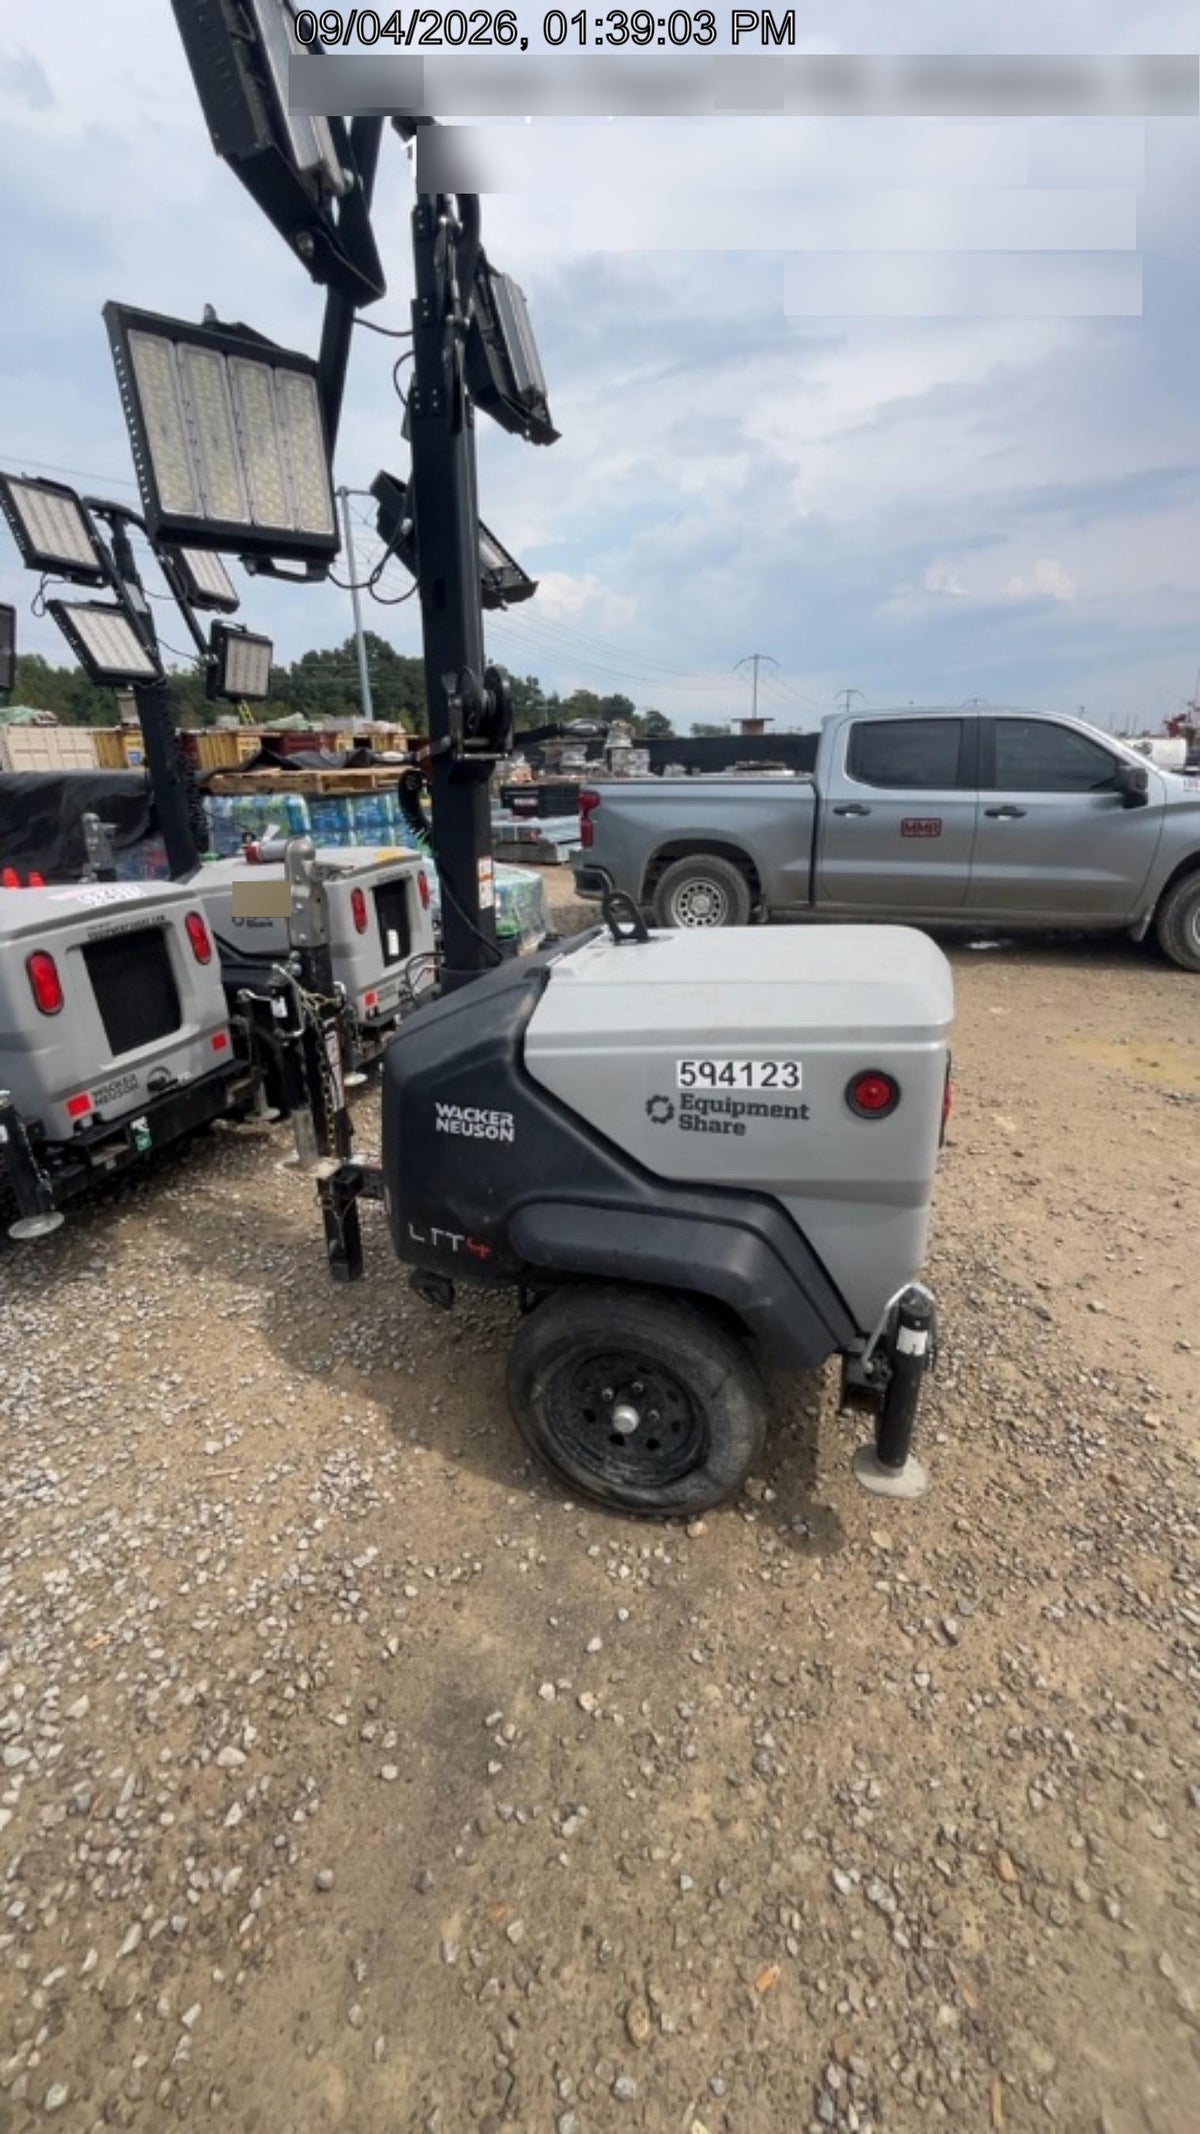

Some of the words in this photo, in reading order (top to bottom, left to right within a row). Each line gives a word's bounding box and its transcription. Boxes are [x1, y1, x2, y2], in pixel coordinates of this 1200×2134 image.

[680, 1061, 800, 1088] 594123
[434, 1102, 514, 1127] WACKER
[679, 1092, 810, 1120] Equipment
[435, 1117, 516, 1142] NEUSON
[678, 1113, 746, 1136] Share
